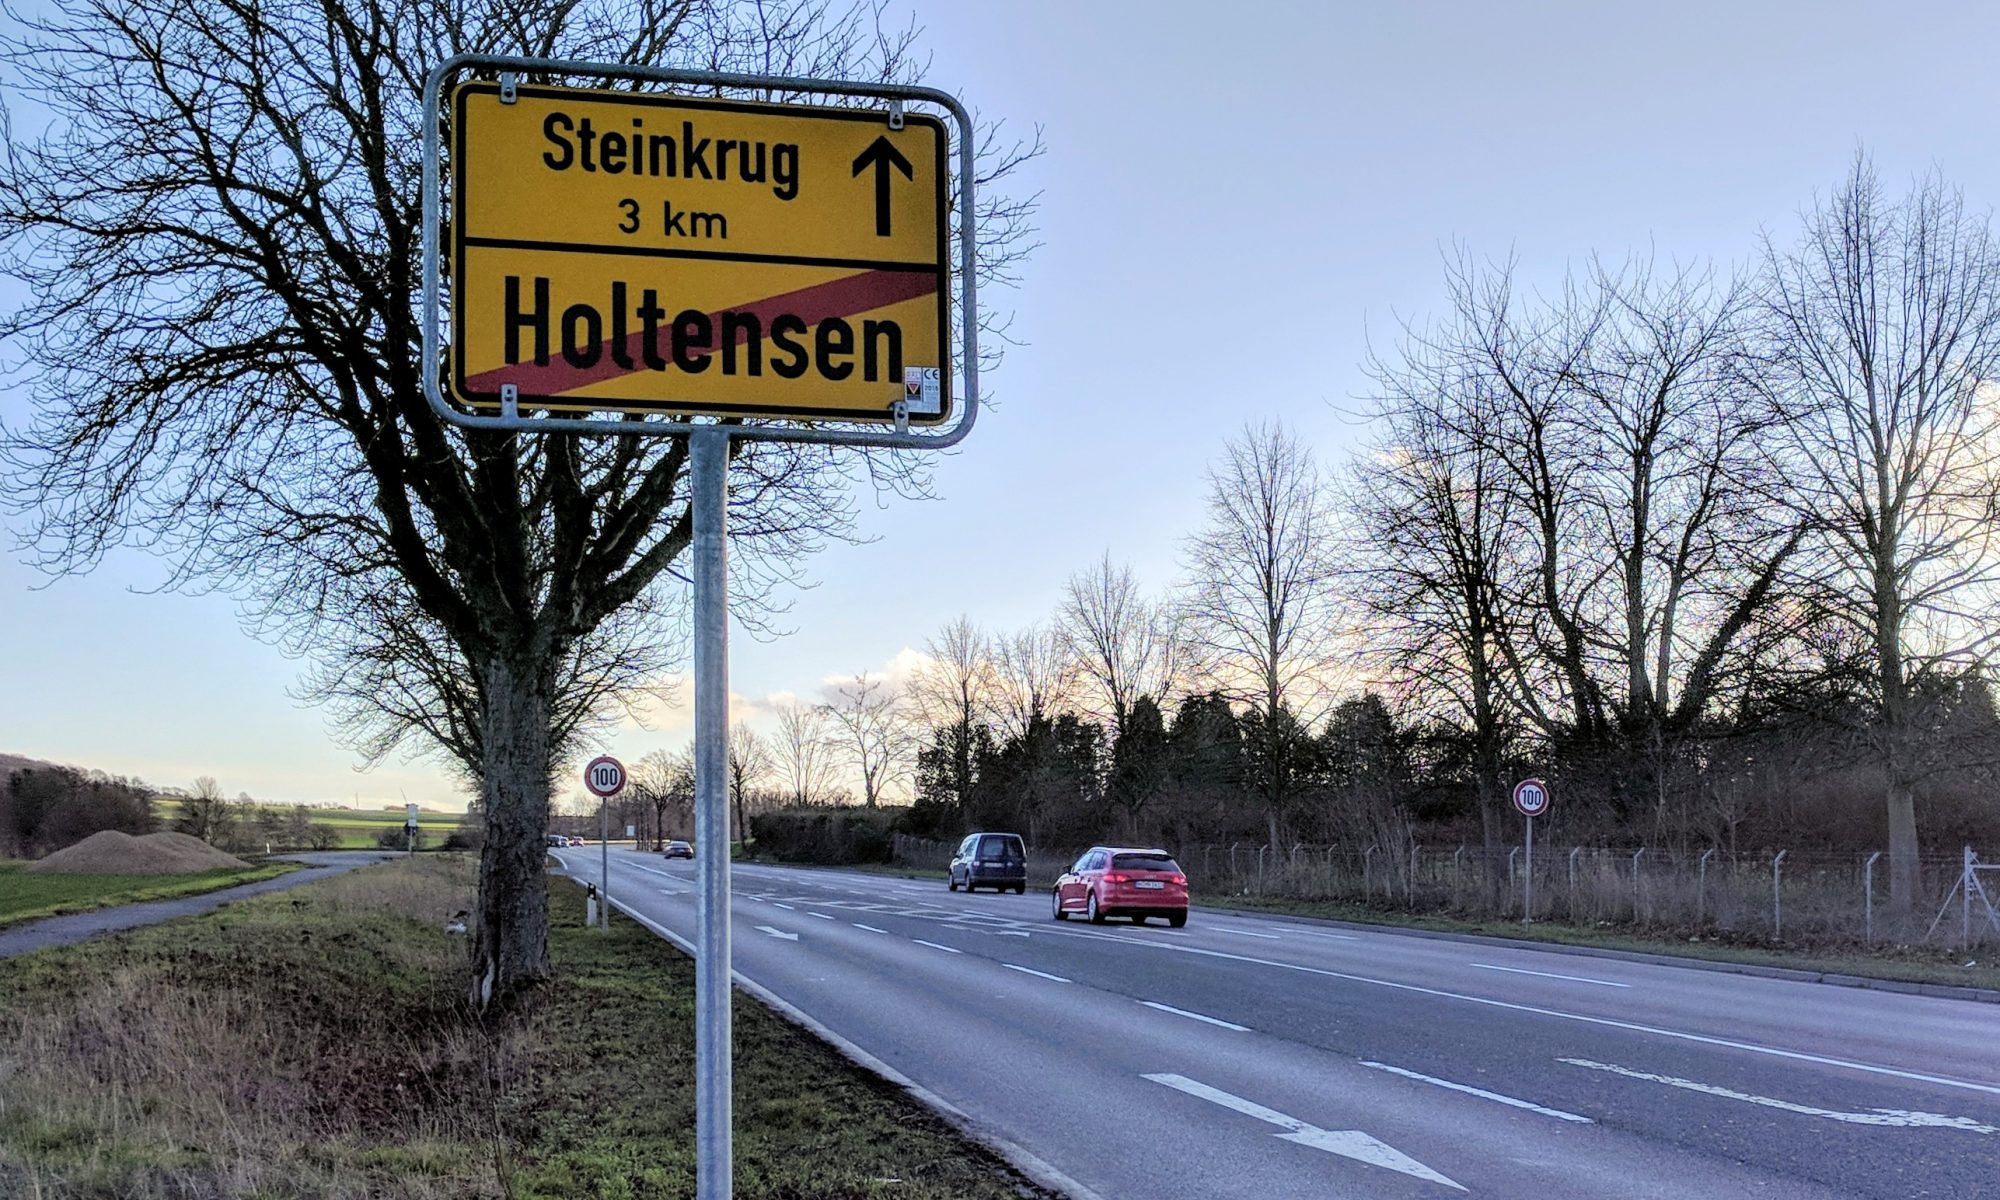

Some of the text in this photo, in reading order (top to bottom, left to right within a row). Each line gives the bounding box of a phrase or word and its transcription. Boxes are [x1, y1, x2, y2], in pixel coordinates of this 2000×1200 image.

[542, 111, 800, 201] Steinkrug
[618, 198, 728, 240] 3 km
[504, 275, 904, 384] Holtensen
[593, 768, 618, 786] 100
[1521, 789, 1541, 806] 100
